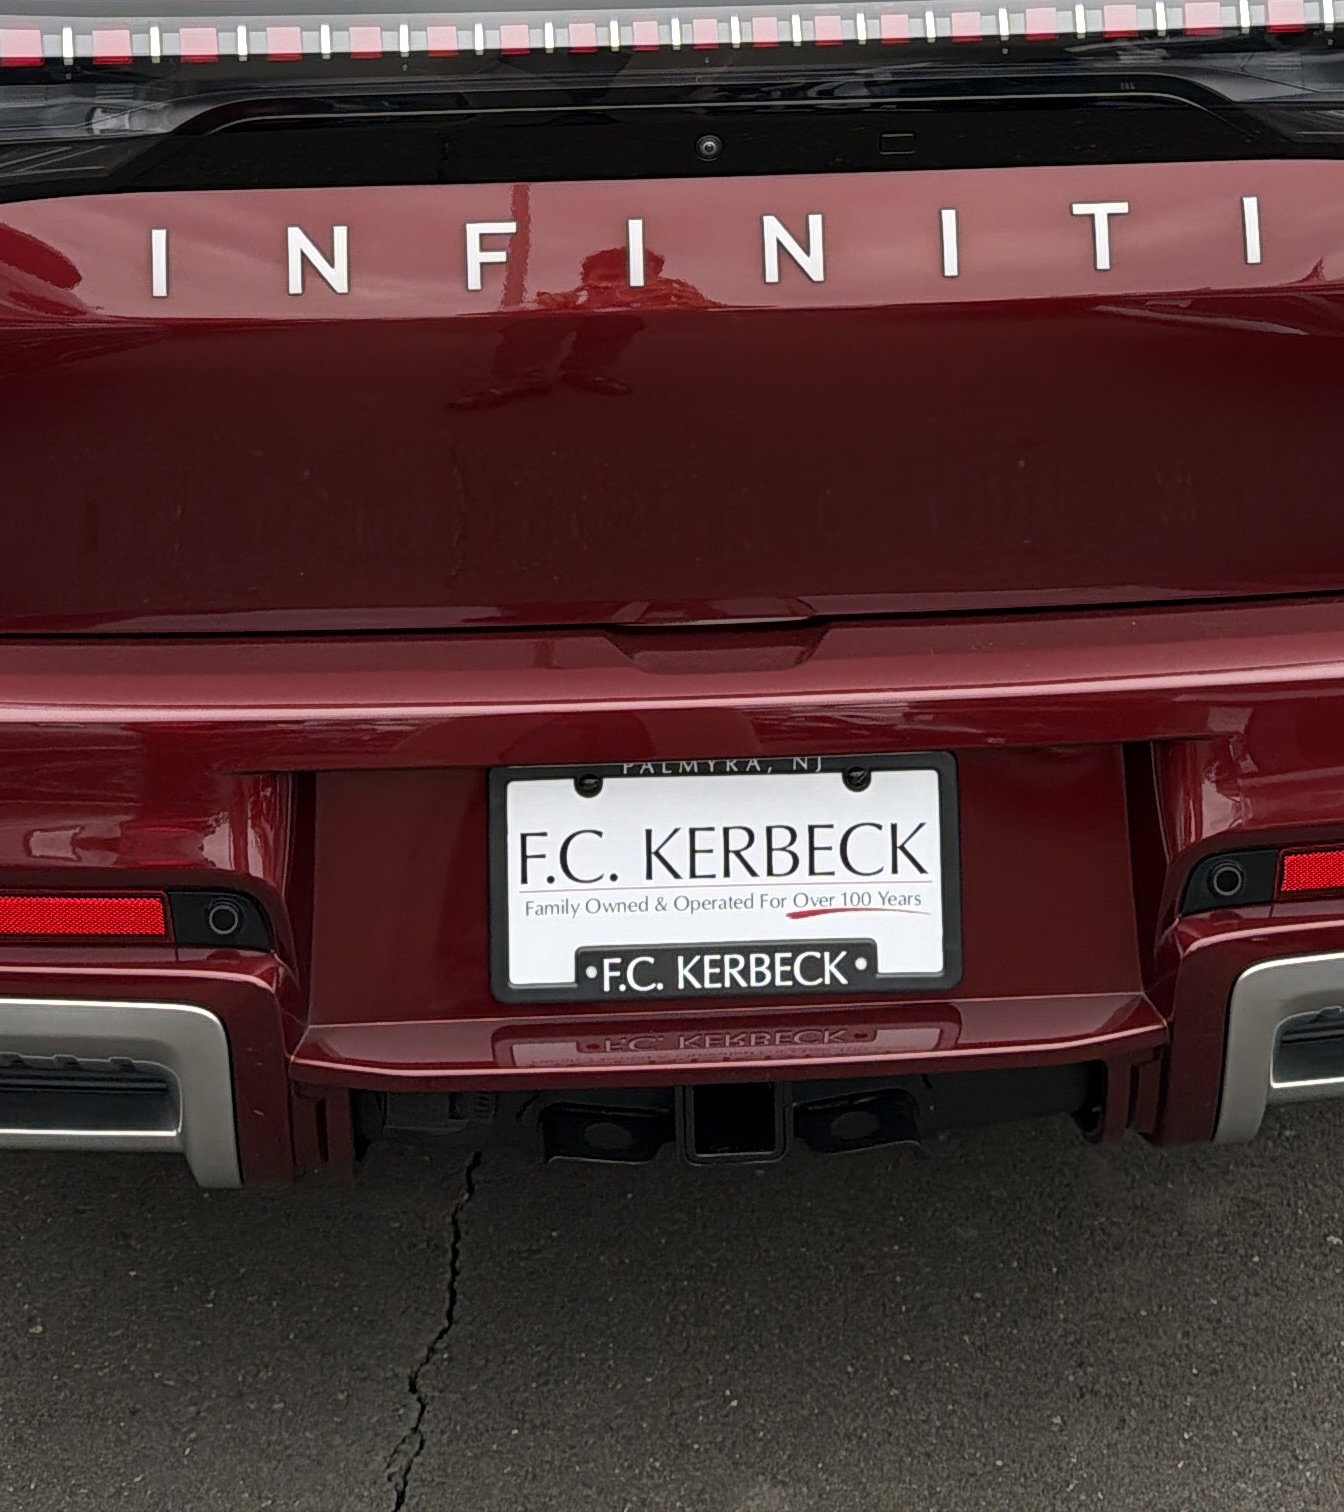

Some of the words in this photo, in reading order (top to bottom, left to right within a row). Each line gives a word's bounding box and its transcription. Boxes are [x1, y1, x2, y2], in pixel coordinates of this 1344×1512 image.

[151, 196, 1262, 297] INFINITI
[792, 756, 822, 773] NJ
[519, 829, 619, 885] F.C.
[644, 821, 929, 881] KERBECK
[525, 897, 580, 918] Family
[585, 896, 649, 914] Owned
[655, 896, 667, 912] &
[673, 892, 754, 916] Operated
[760, 893, 787, 909] For
[793, 891, 836, 909] Over
[842, 891, 872, 907] 100
[877, 890, 922, 907] Years
[602, 957, 665, 993] F.C.
[677, 951, 849, 990] KERBECK
